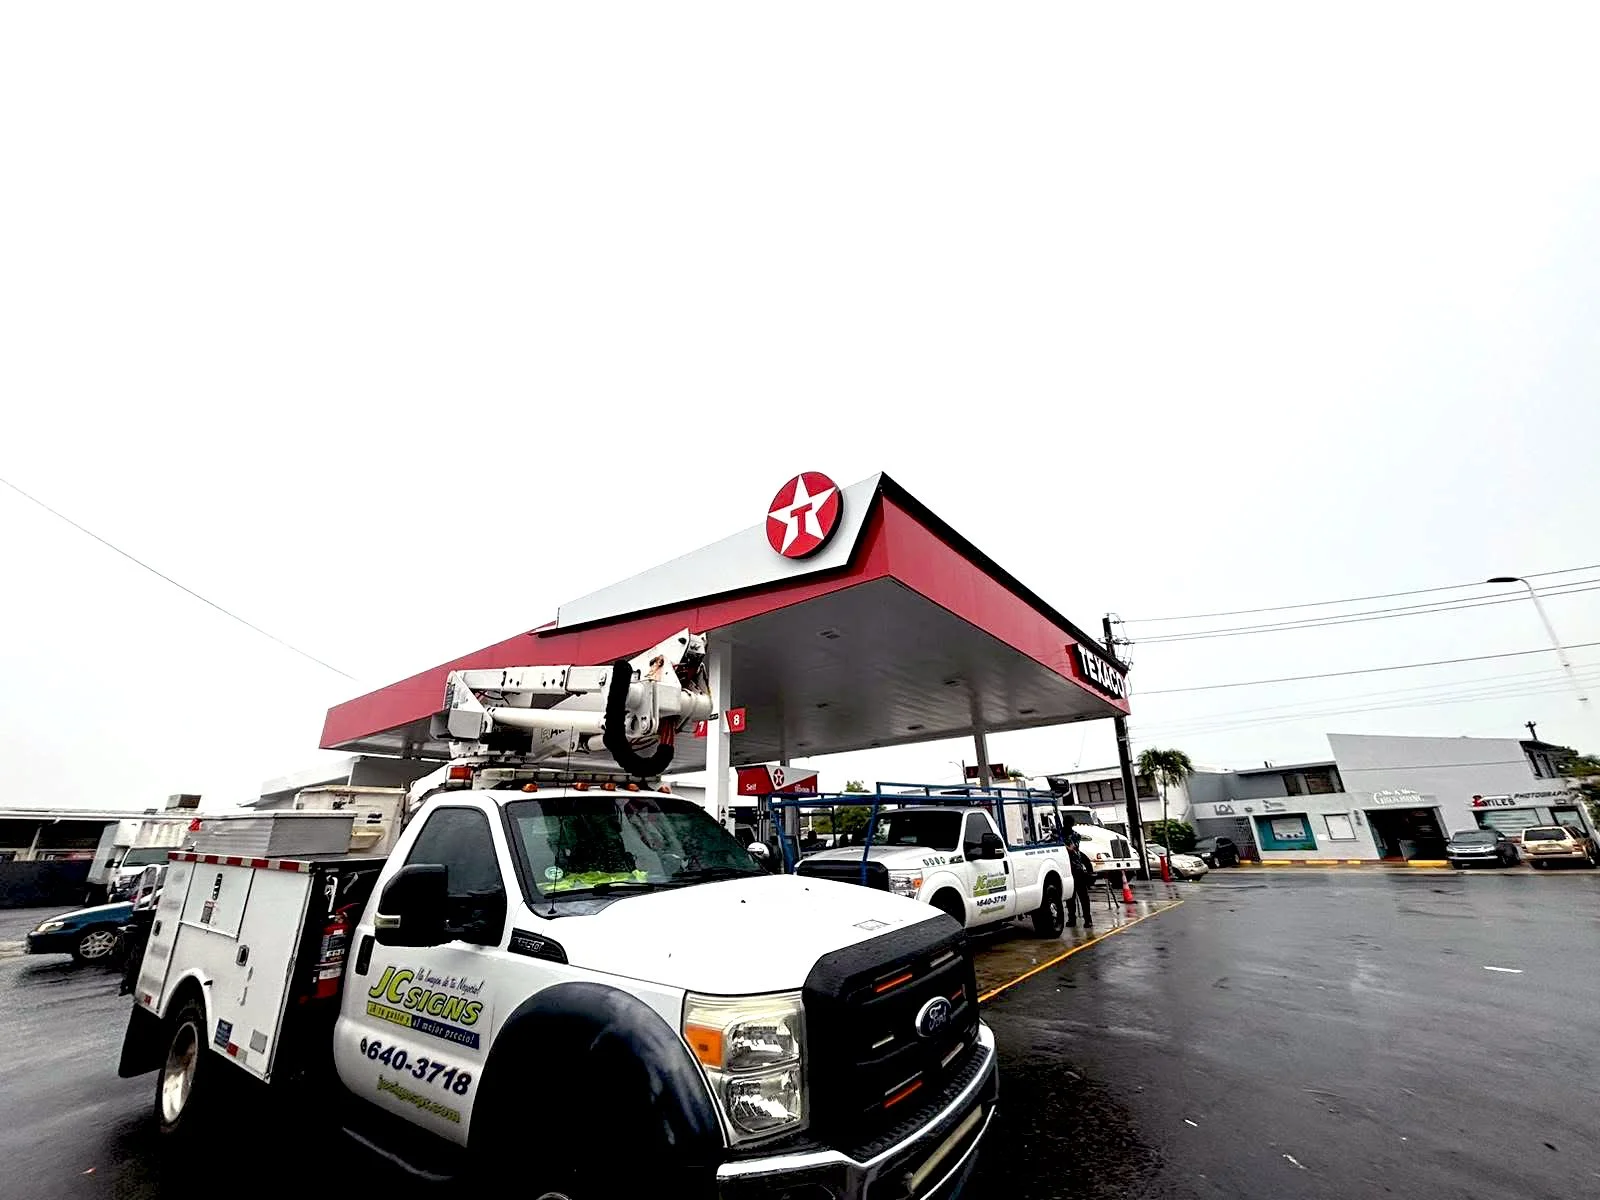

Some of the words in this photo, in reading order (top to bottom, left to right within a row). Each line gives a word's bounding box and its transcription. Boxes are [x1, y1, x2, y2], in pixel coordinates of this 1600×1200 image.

[1077, 643, 1126, 699] TEXACO
[698, 721, 705, 732] 7
[733, 714, 741, 726] 8
[403, 987, 483, 1026] SIGNS
[421, 1022, 444, 1036] mejor
[444, 1029, 475, 1045] precio!
[366, 1039, 472, 1095] 640-3718
